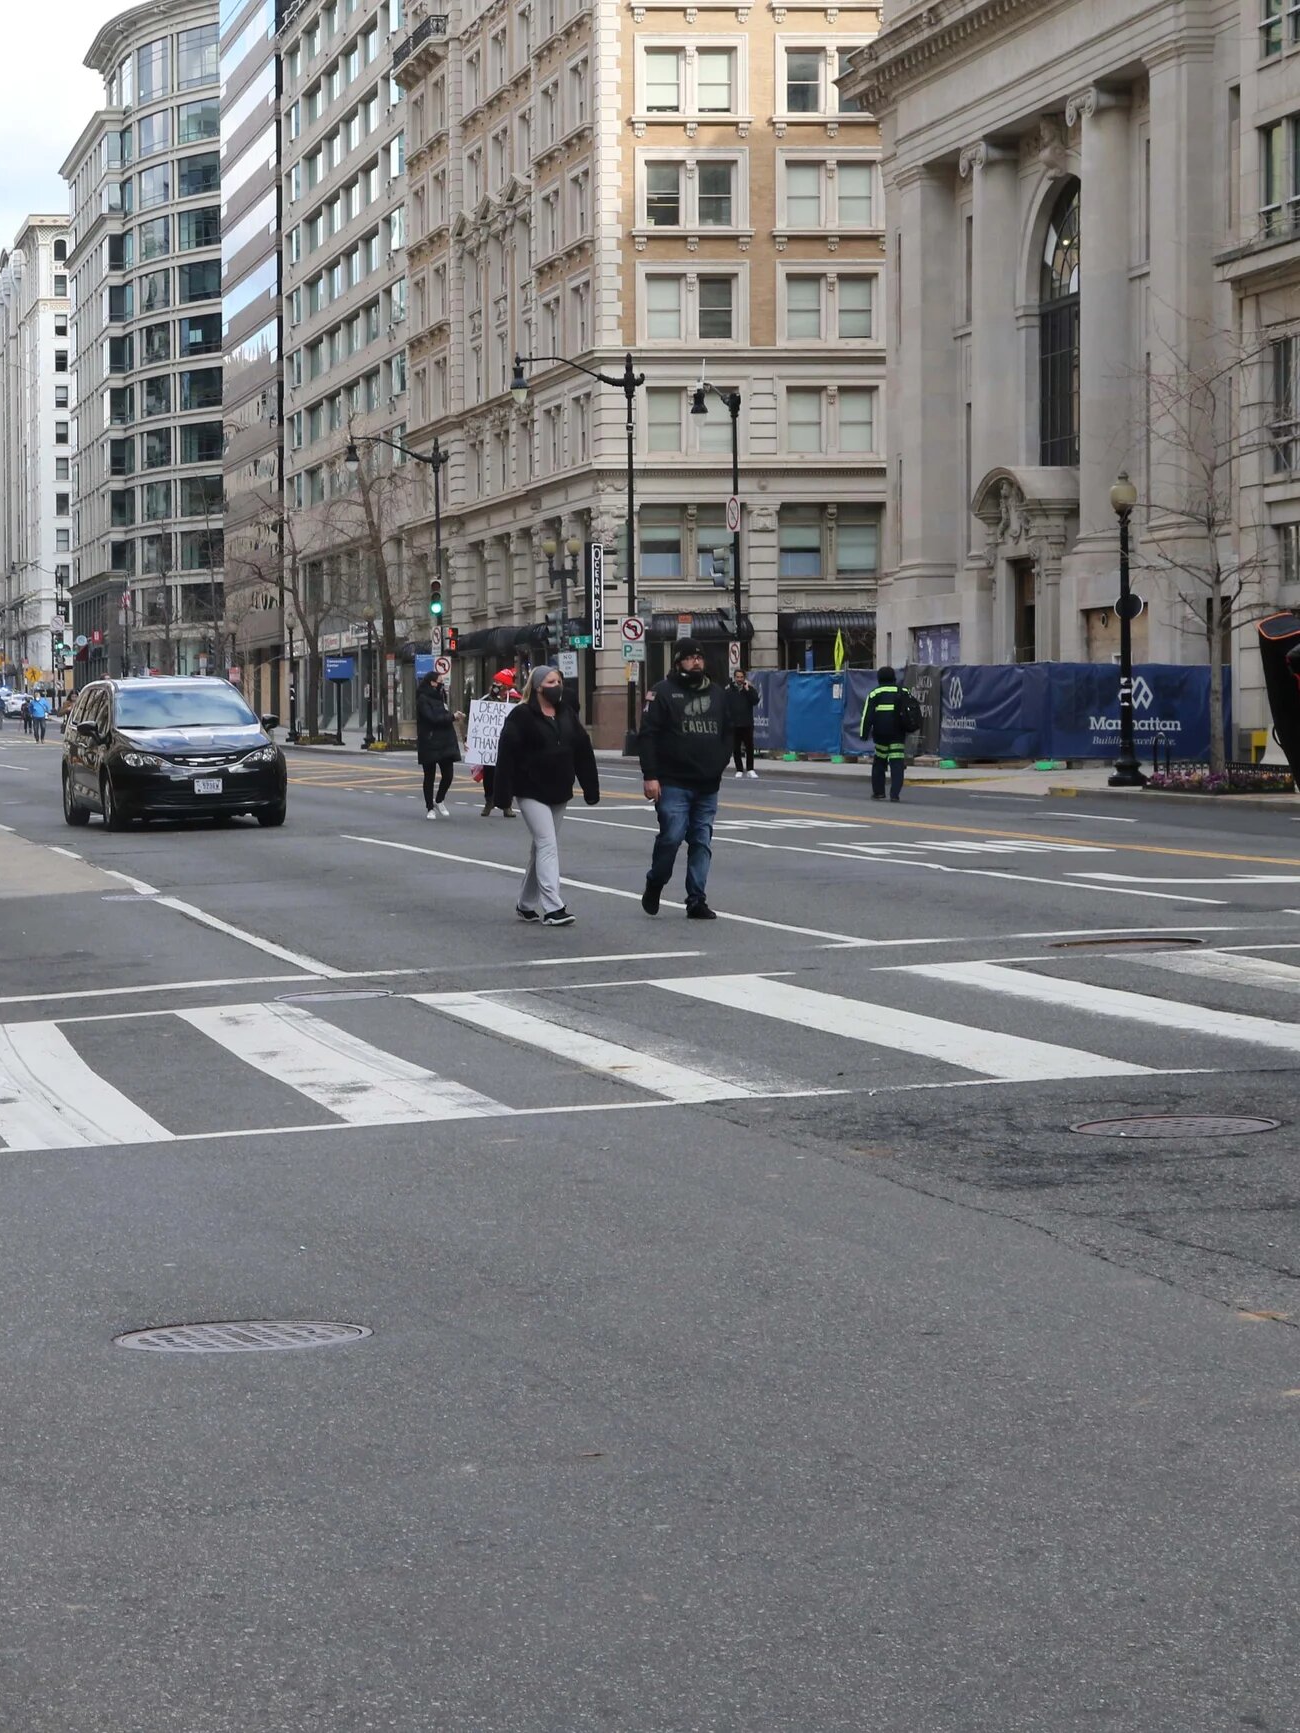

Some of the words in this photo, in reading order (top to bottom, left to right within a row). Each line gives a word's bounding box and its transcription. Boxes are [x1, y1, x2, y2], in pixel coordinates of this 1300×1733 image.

[623, 644, 632, 657] P
[479, 702, 506, 714] DEAR
[473, 713, 503, 726] WOME
[483, 726, 499, 738] COL
[682, 720, 718, 735] EAGLES
[472, 736, 497, 750] THAN
[478, 750, 497, 764] YOU
